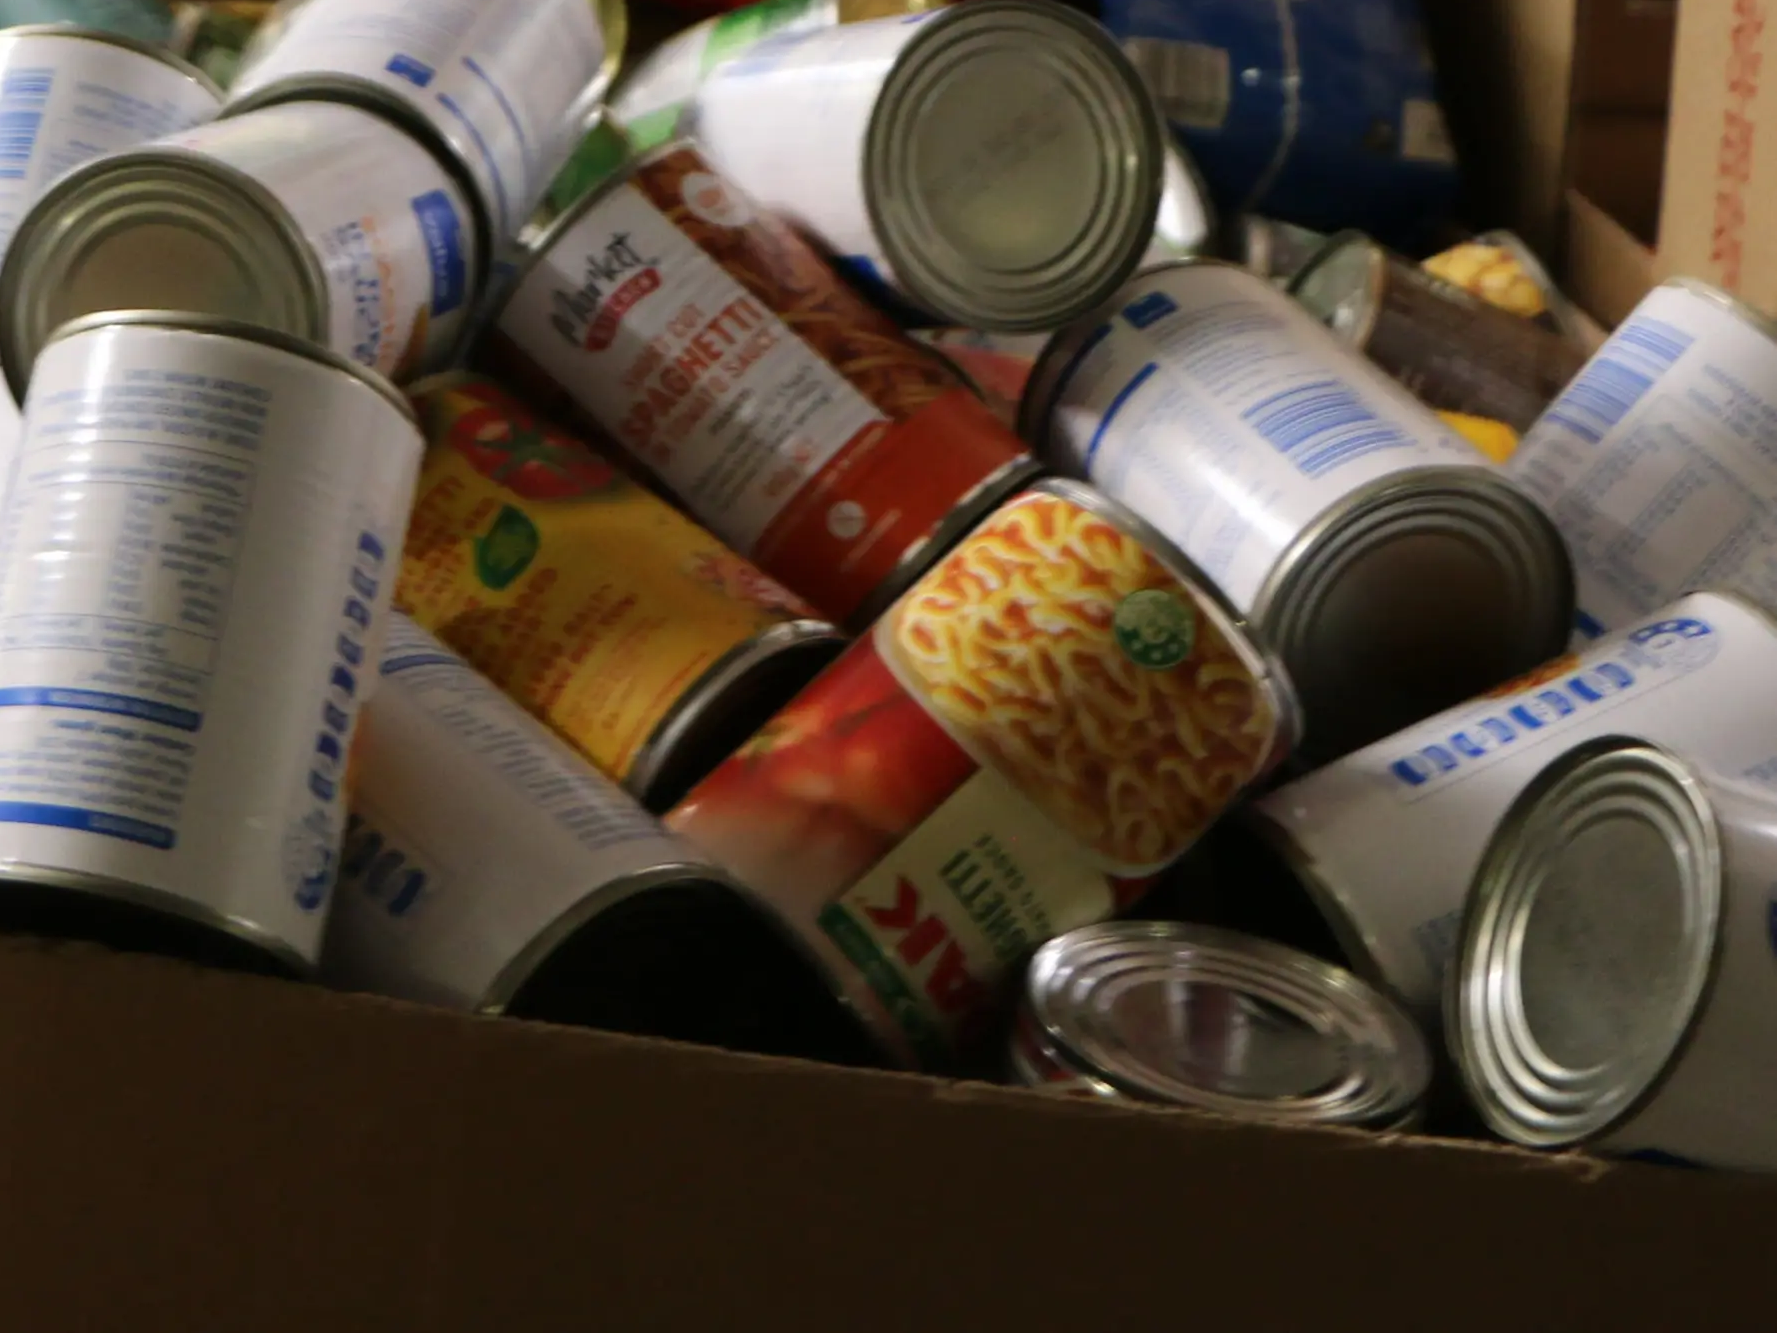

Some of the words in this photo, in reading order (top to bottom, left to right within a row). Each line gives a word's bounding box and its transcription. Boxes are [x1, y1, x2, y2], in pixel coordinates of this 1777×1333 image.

[551, 234, 643, 345] Market
[724, 329, 776, 377] SAUCE
[623, 298, 763, 444] SPAGHETTI
[863, 875, 995, 1019] AK
